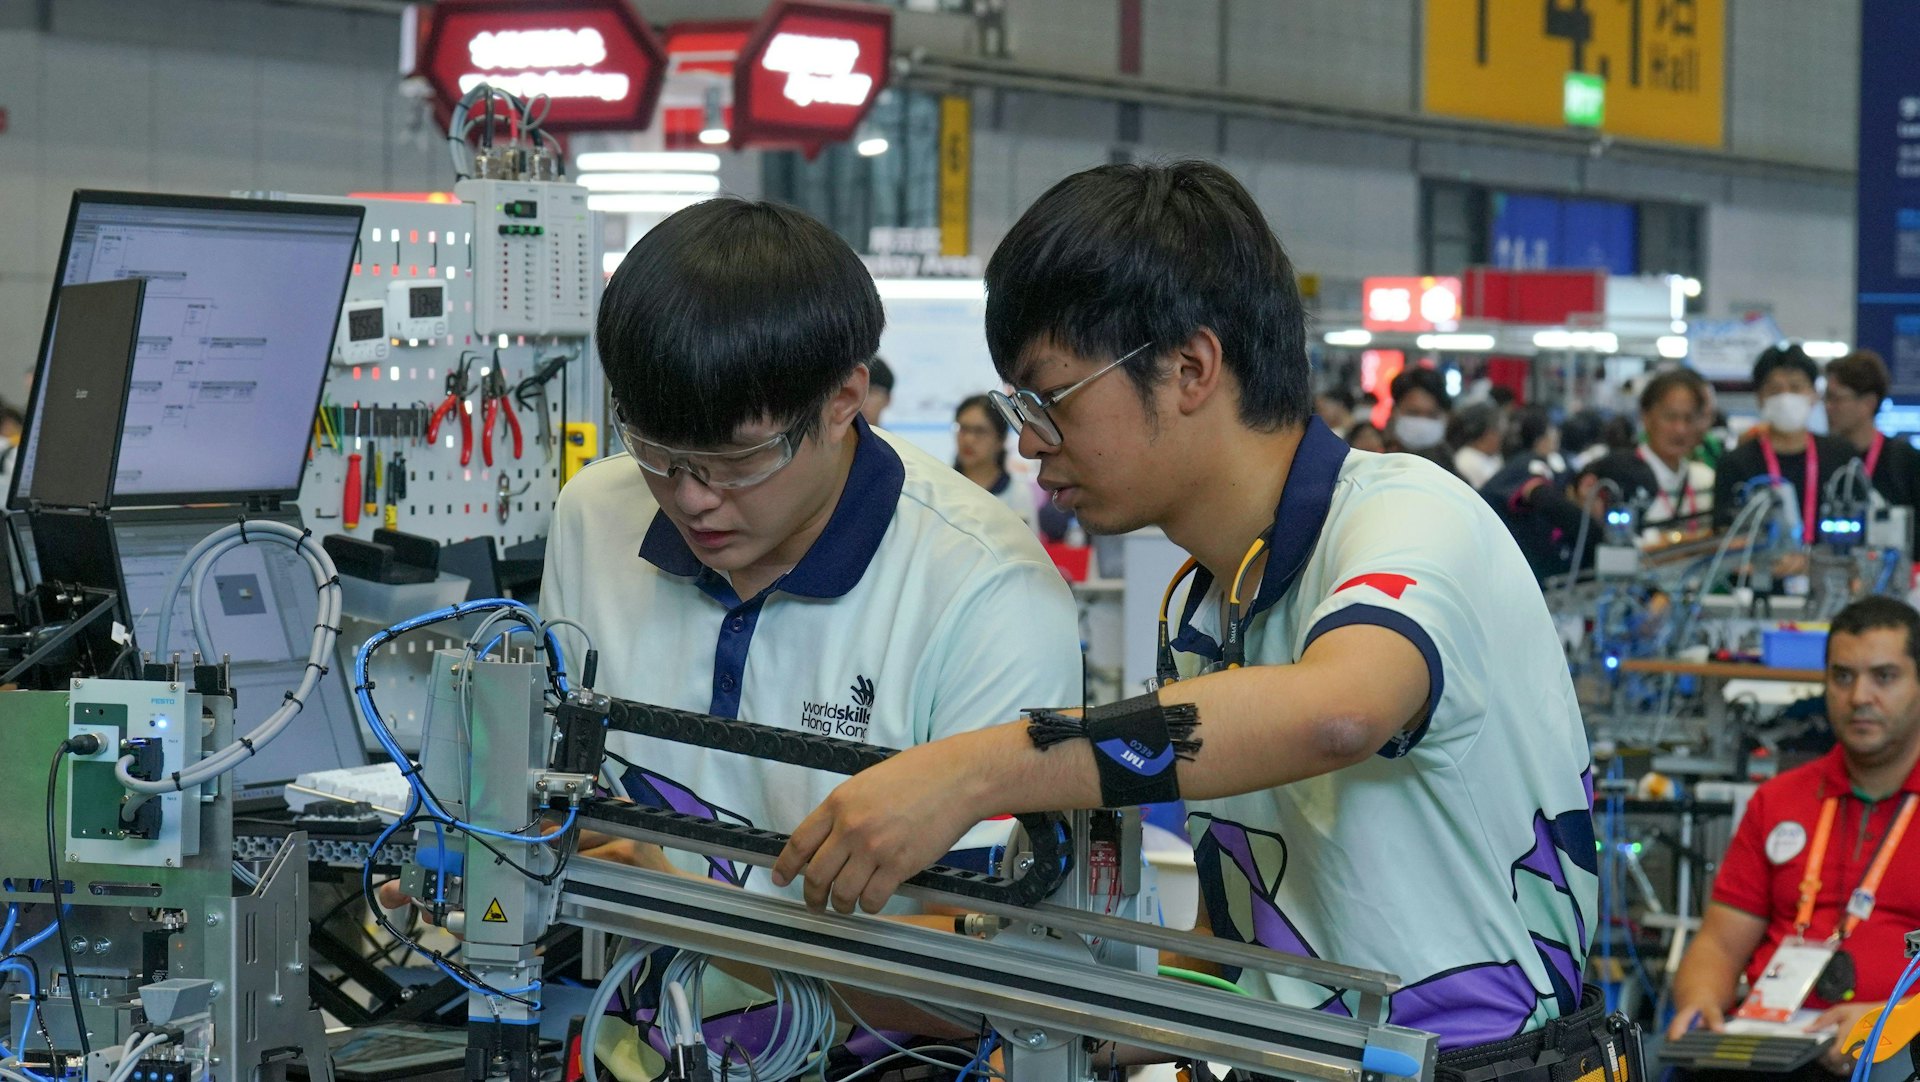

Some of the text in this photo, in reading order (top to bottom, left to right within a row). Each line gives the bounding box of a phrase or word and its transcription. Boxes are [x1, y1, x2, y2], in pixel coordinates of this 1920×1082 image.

[801, 712, 832, 736] Hong
[1129, 740, 1154, 757] RECO
[1120, 750, 1145, 769] TMT
